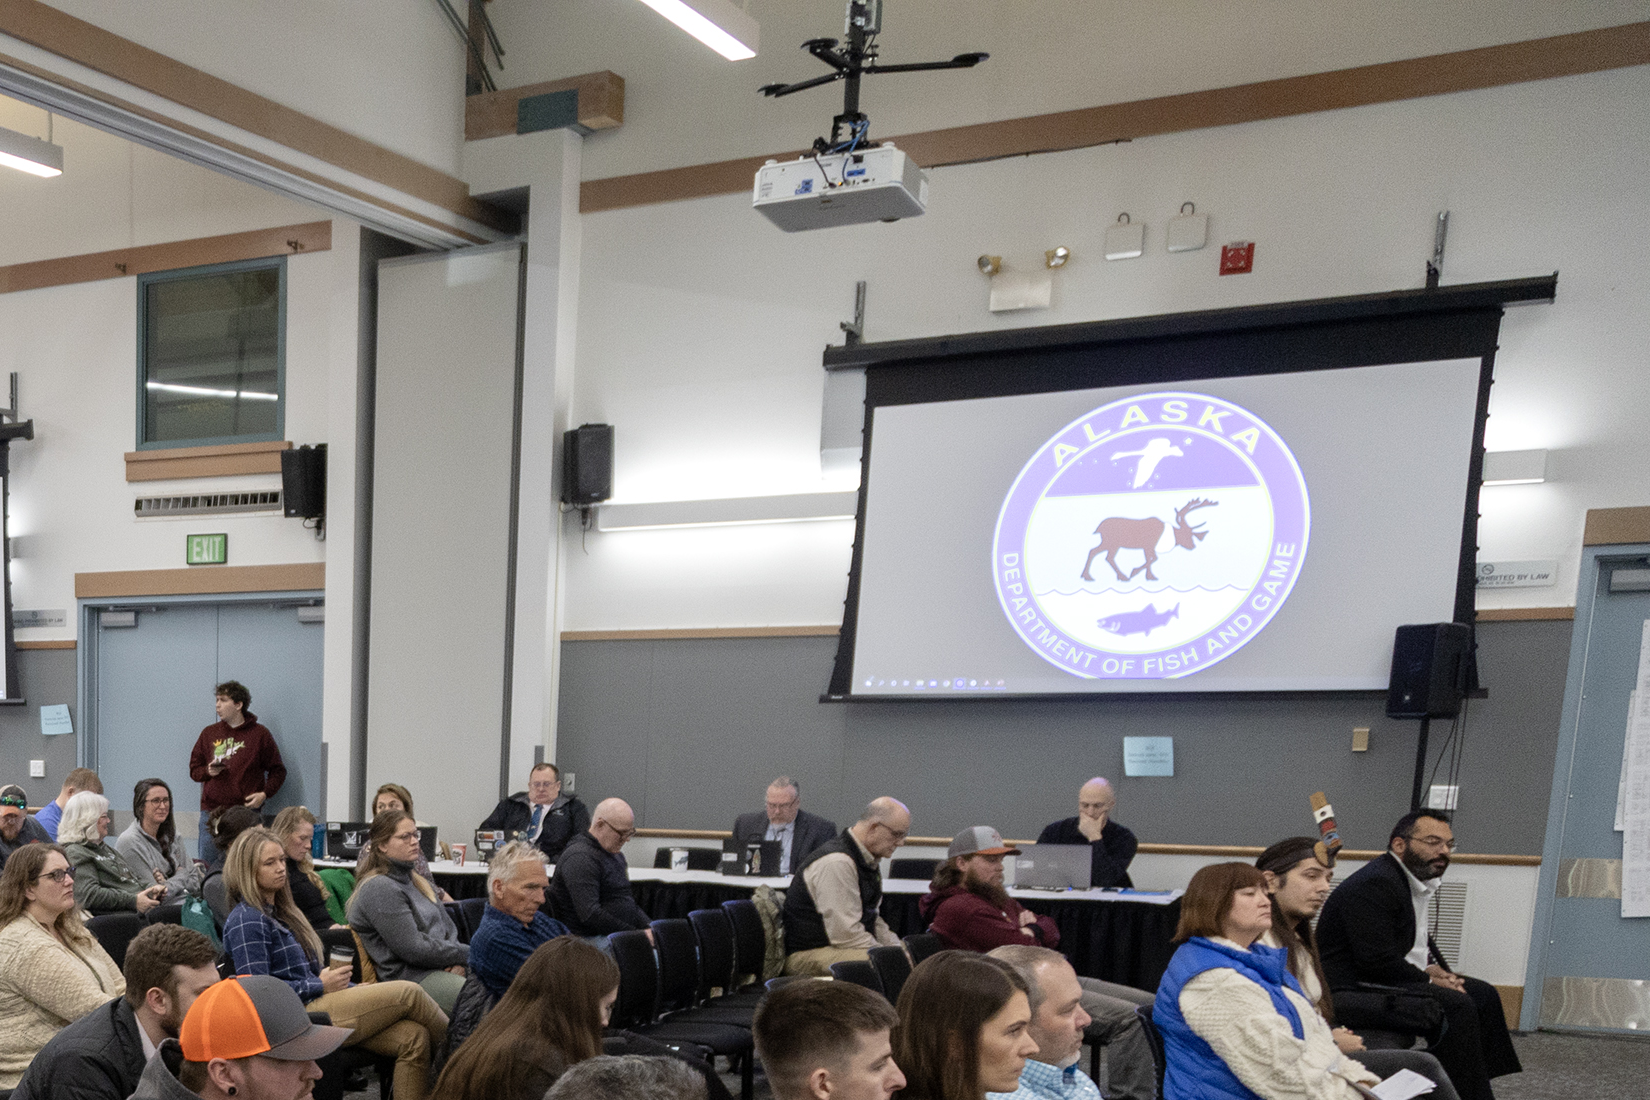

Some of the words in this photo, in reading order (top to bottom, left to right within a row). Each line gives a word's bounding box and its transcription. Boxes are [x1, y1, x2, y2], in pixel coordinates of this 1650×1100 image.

[1052, 400, 1262, 469] ALASKA
[192, 536, 222, 562] EXIT
[1001, 552, 1098, 669] DEPARTMENT
[1102, 658, 1135, 675] OF
[1143, 646, 1199, 674] FISH
[1206, 612, 1254, 654] AND
[1251, 541, 1296, 612] GAME
